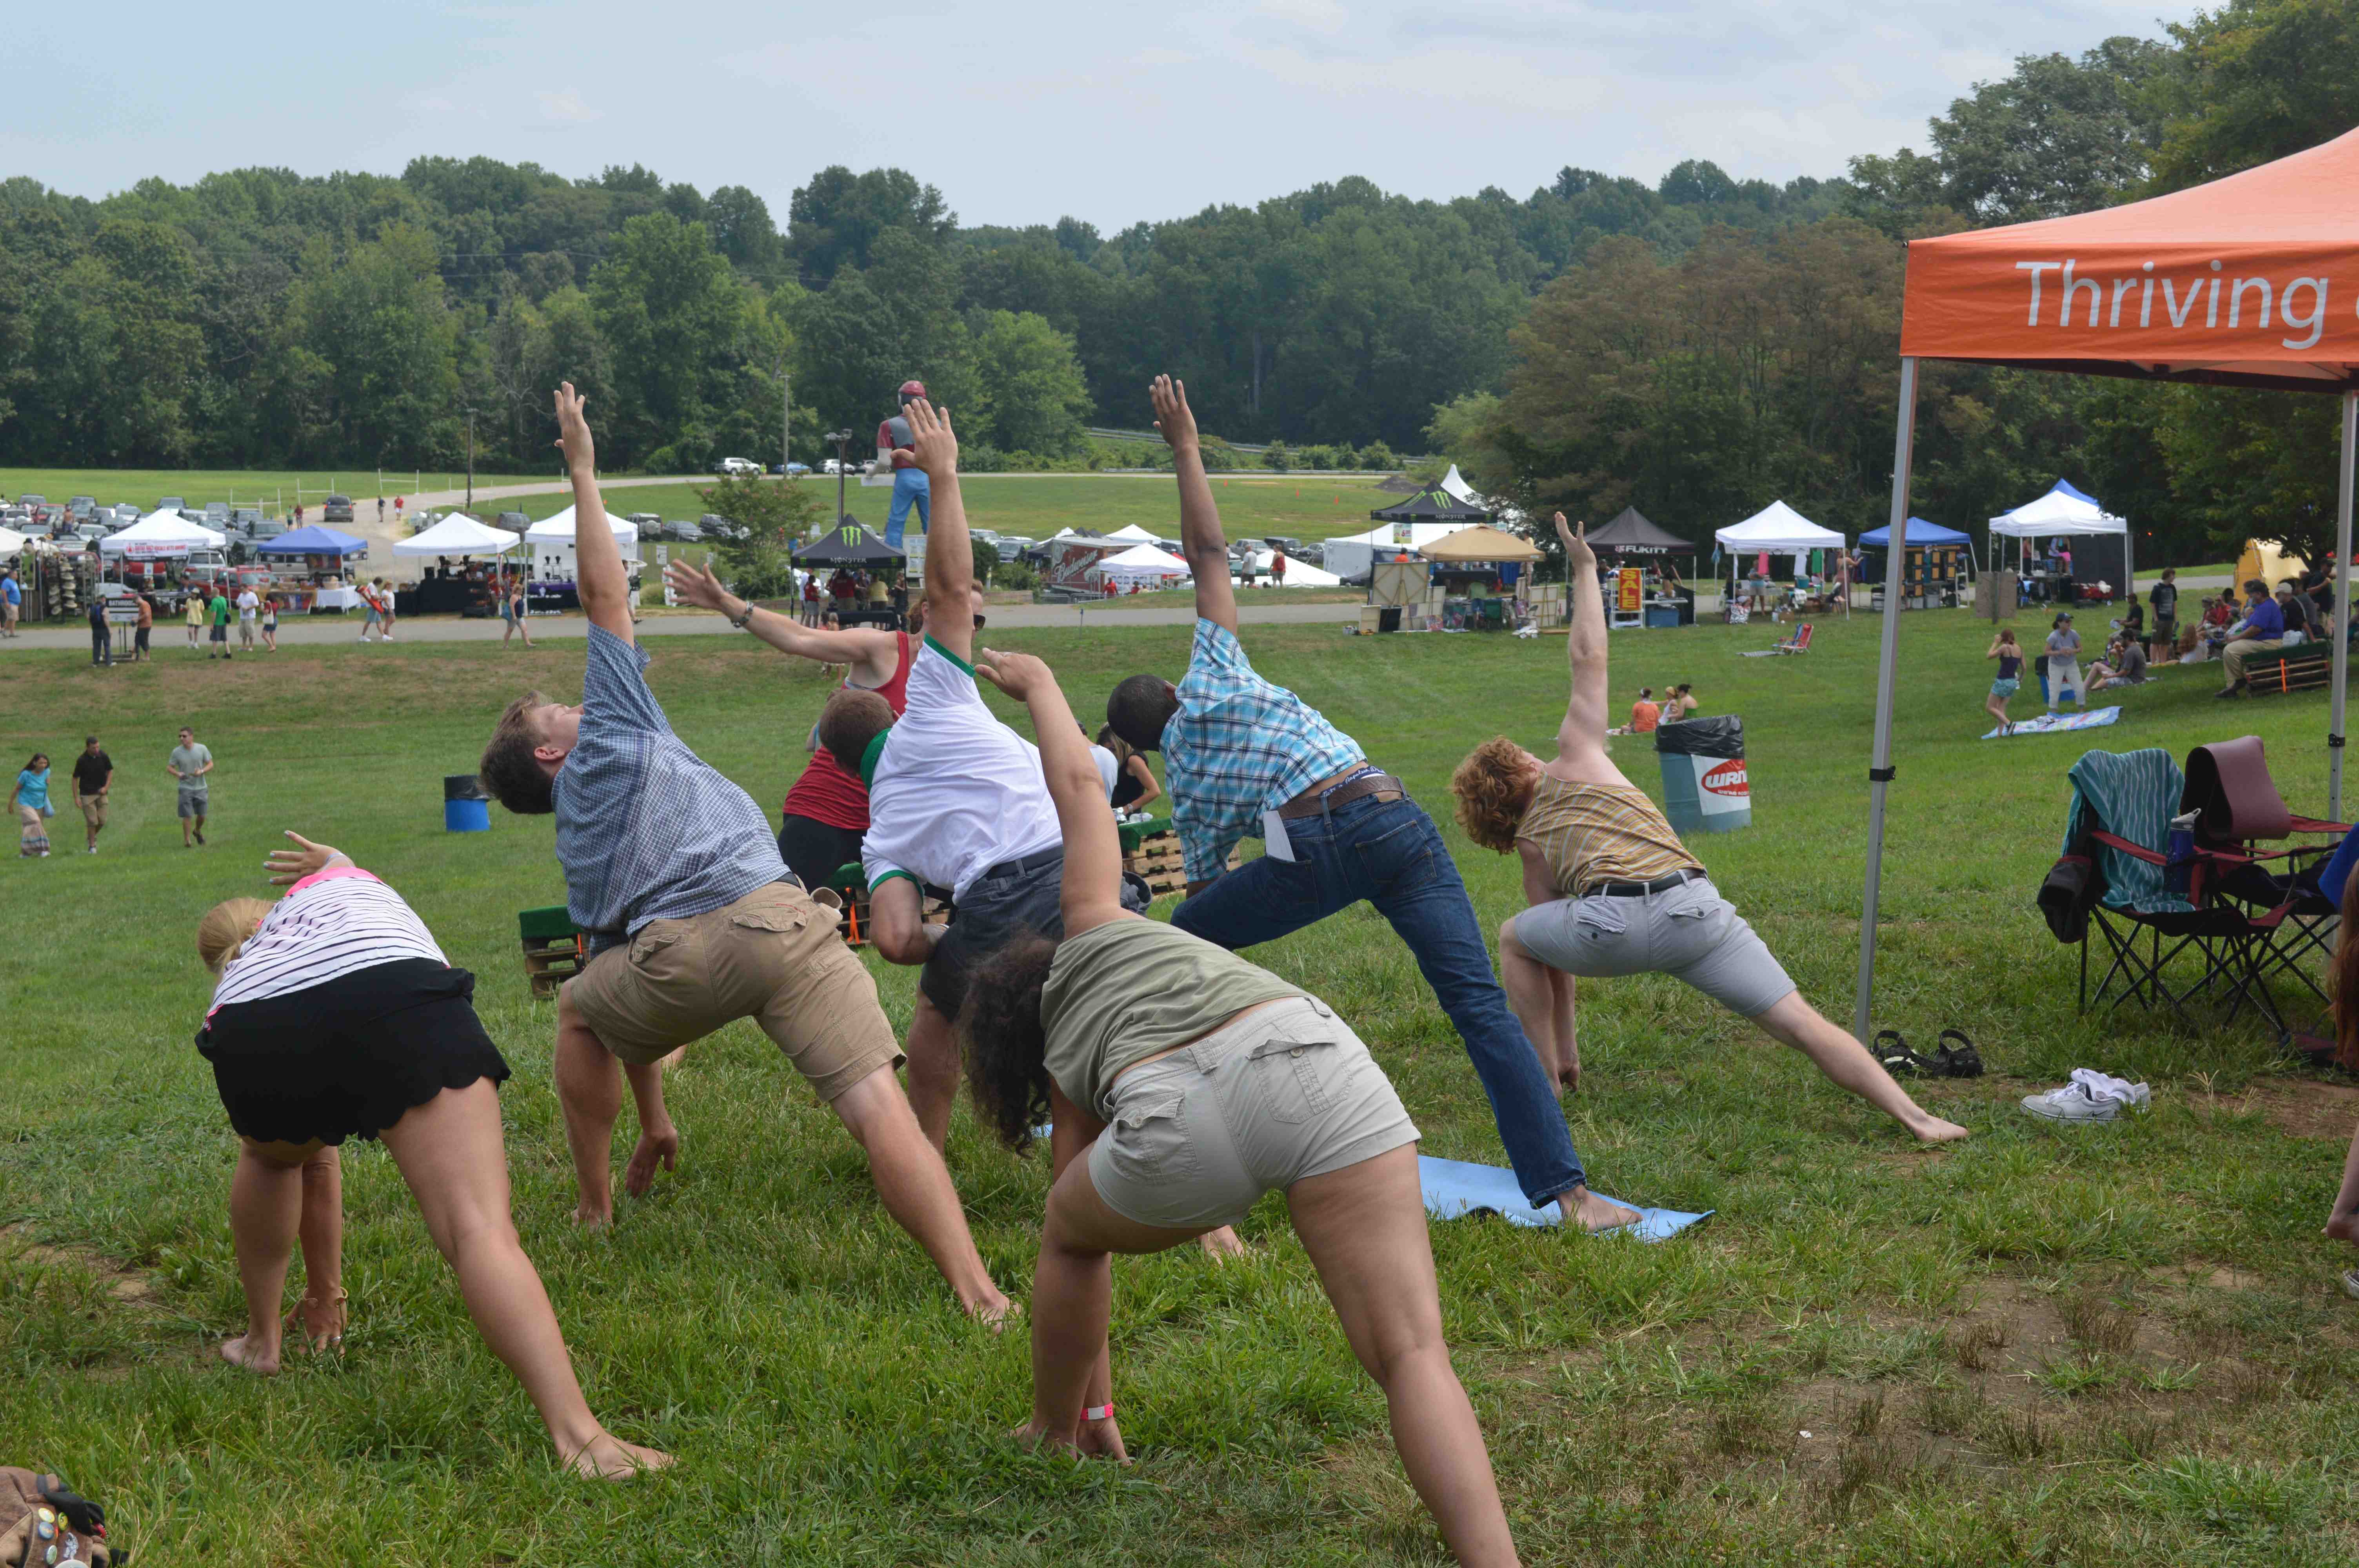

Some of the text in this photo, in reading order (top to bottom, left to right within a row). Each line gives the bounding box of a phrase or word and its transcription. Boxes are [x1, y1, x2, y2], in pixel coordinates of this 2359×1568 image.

[2015, 259, 2328, 349] Thriving
[1053, 550, 1098, 583] Budweiser
[1622, 570, 1637, 607] SALE
[1706, 769, 1748, 788] WRN
